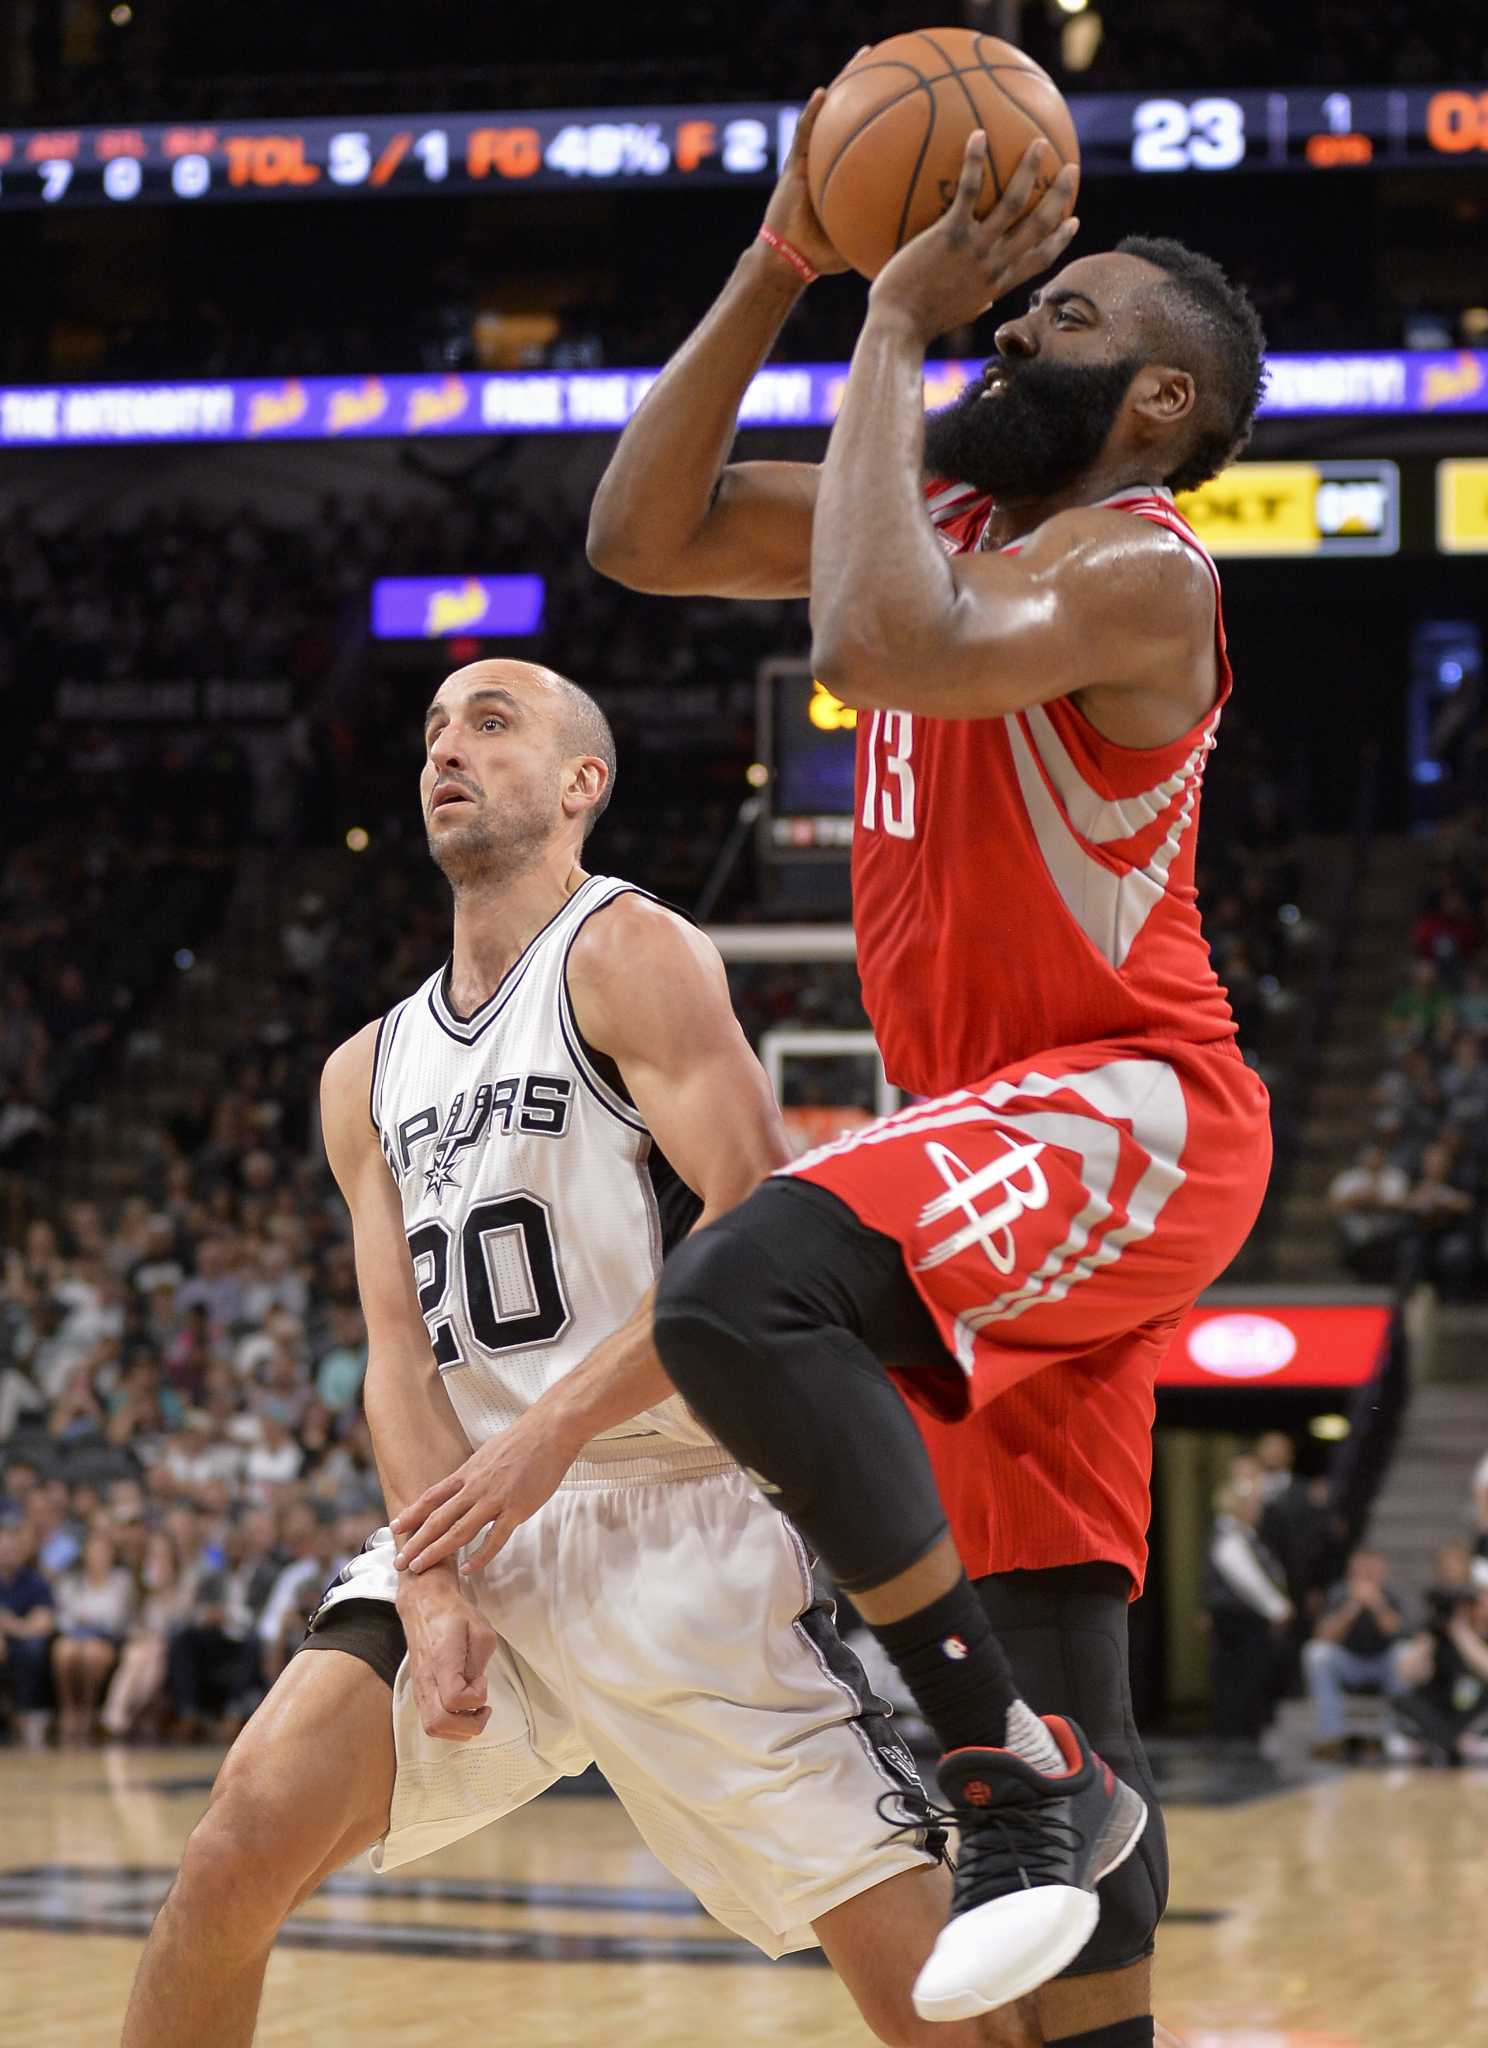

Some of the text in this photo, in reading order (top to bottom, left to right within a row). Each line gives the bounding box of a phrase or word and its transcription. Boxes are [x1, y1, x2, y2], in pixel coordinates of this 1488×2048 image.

[224, 135, 320, 187] TOL
[676, 119, 716, 173] F
[722, 118, 768, 174] 2
[1132, 97, 1245, 172] 23
[1427, 89, 1488, 153] 0
[38, 159, 73, 203] 7
[862, 709, 915, 841] 13
[405, 1188, 575, 1372] 20
